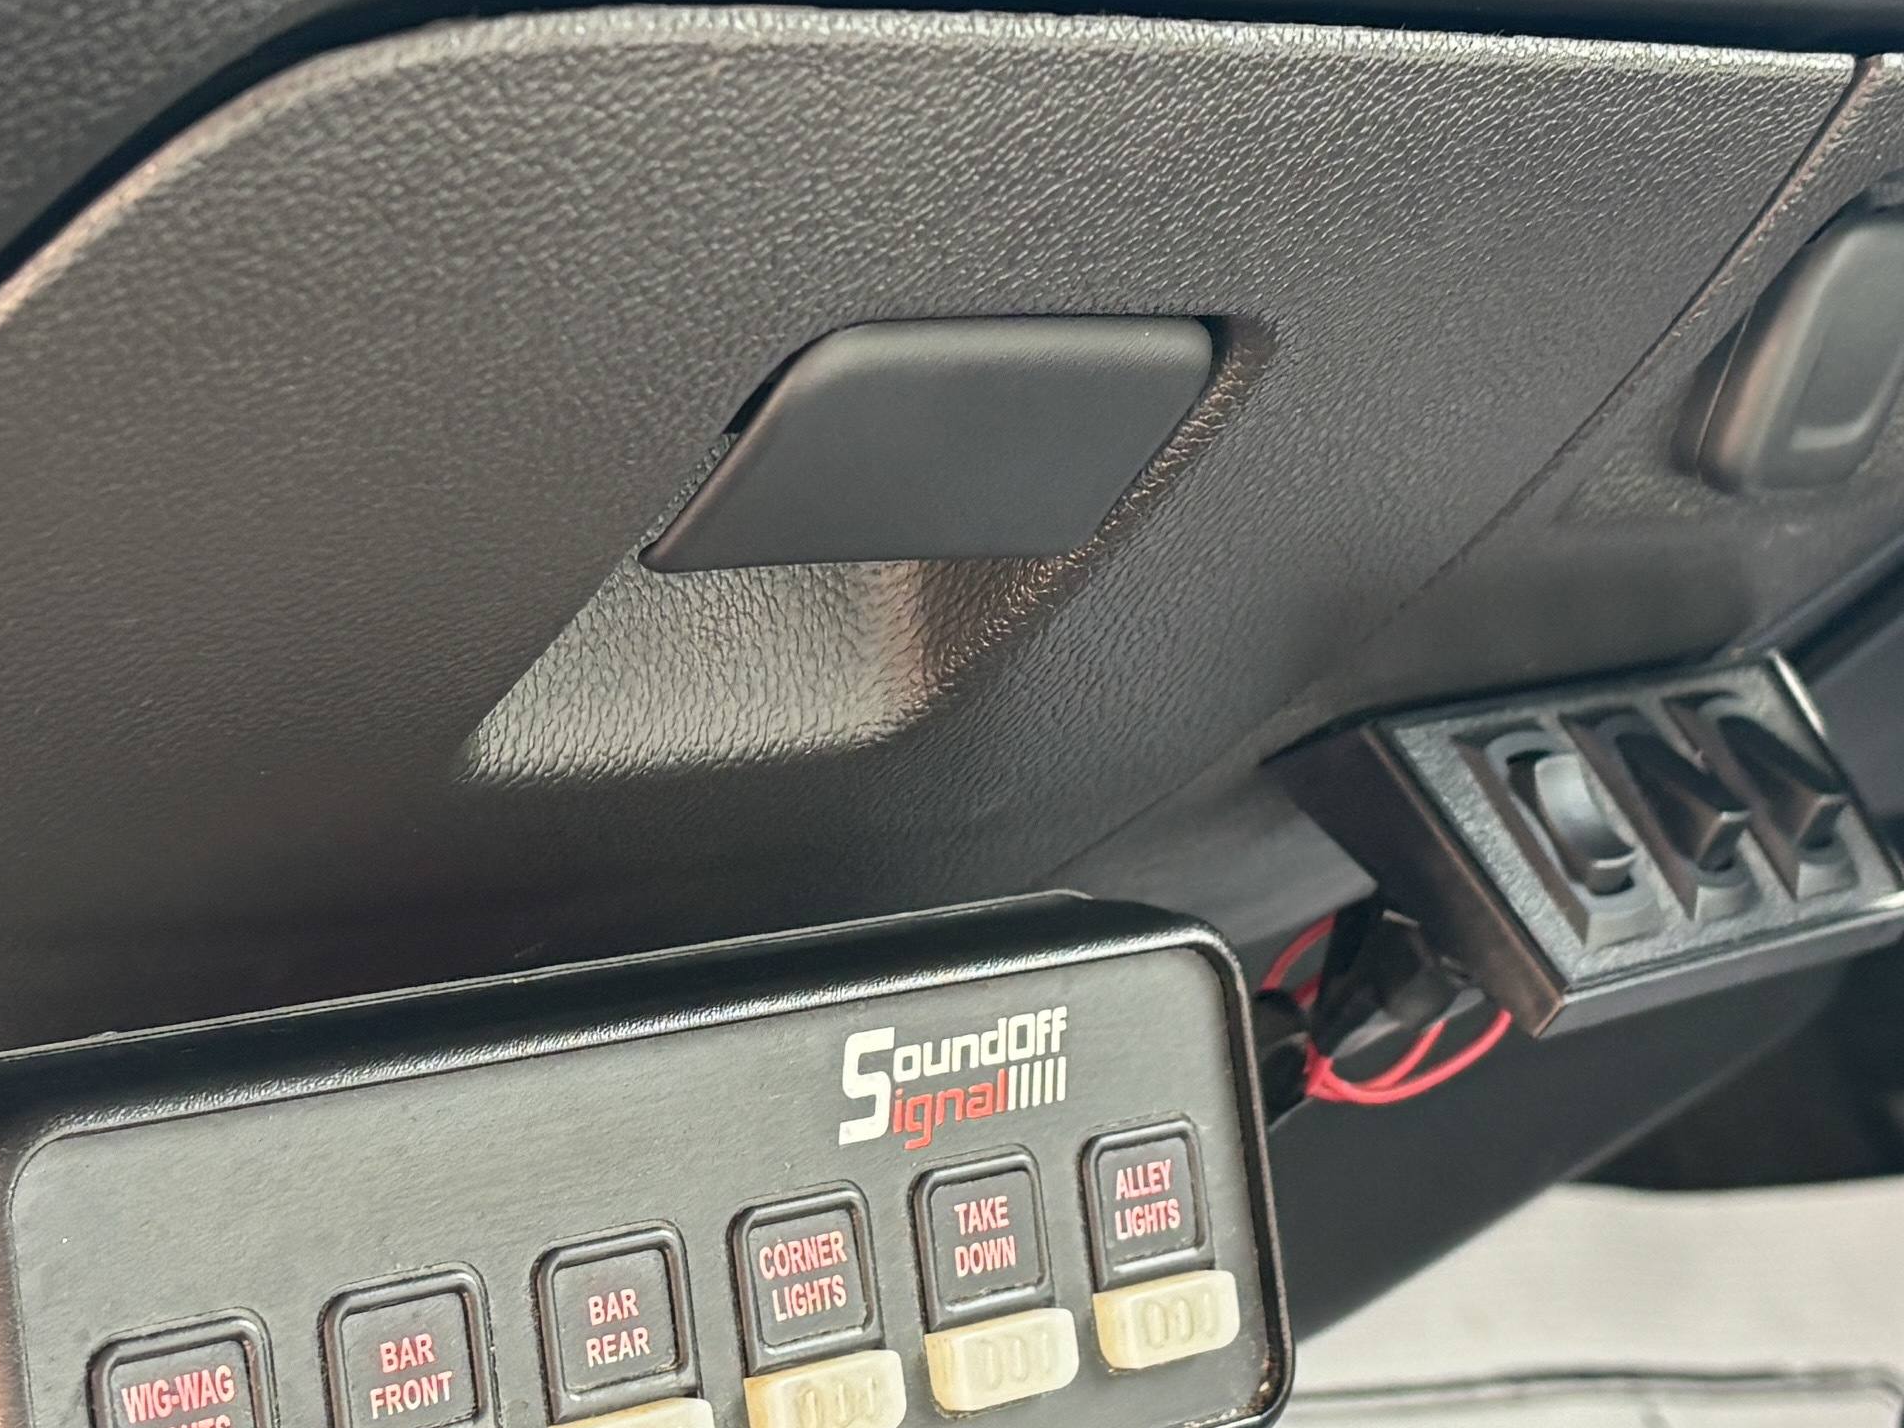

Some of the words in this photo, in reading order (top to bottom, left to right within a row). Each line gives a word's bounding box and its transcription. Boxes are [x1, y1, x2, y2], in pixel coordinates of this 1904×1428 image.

[838, 1005, 1068, 1147] SoundOff
[1116, 1158, 1172, 1201] ALLEY
[953, 1195, 1010, 1236] TAKE
[1114, 1198, 1181, 1241] LIGHTS
[758, 1230, 848, 1281] CORNER
[954, 1235, 1017, 1278] DOWN
[587, 1288, 640, 1326] BAR
[771, 1274, 847, 1322] LIGHTS
[379, 1333, 437, 1374] BAR
[585, 1326, 651, 1368] REAR
[120, 1364, 235, 1424] WIG-WAG
[369, 1371, 454, 1420] FRONT
